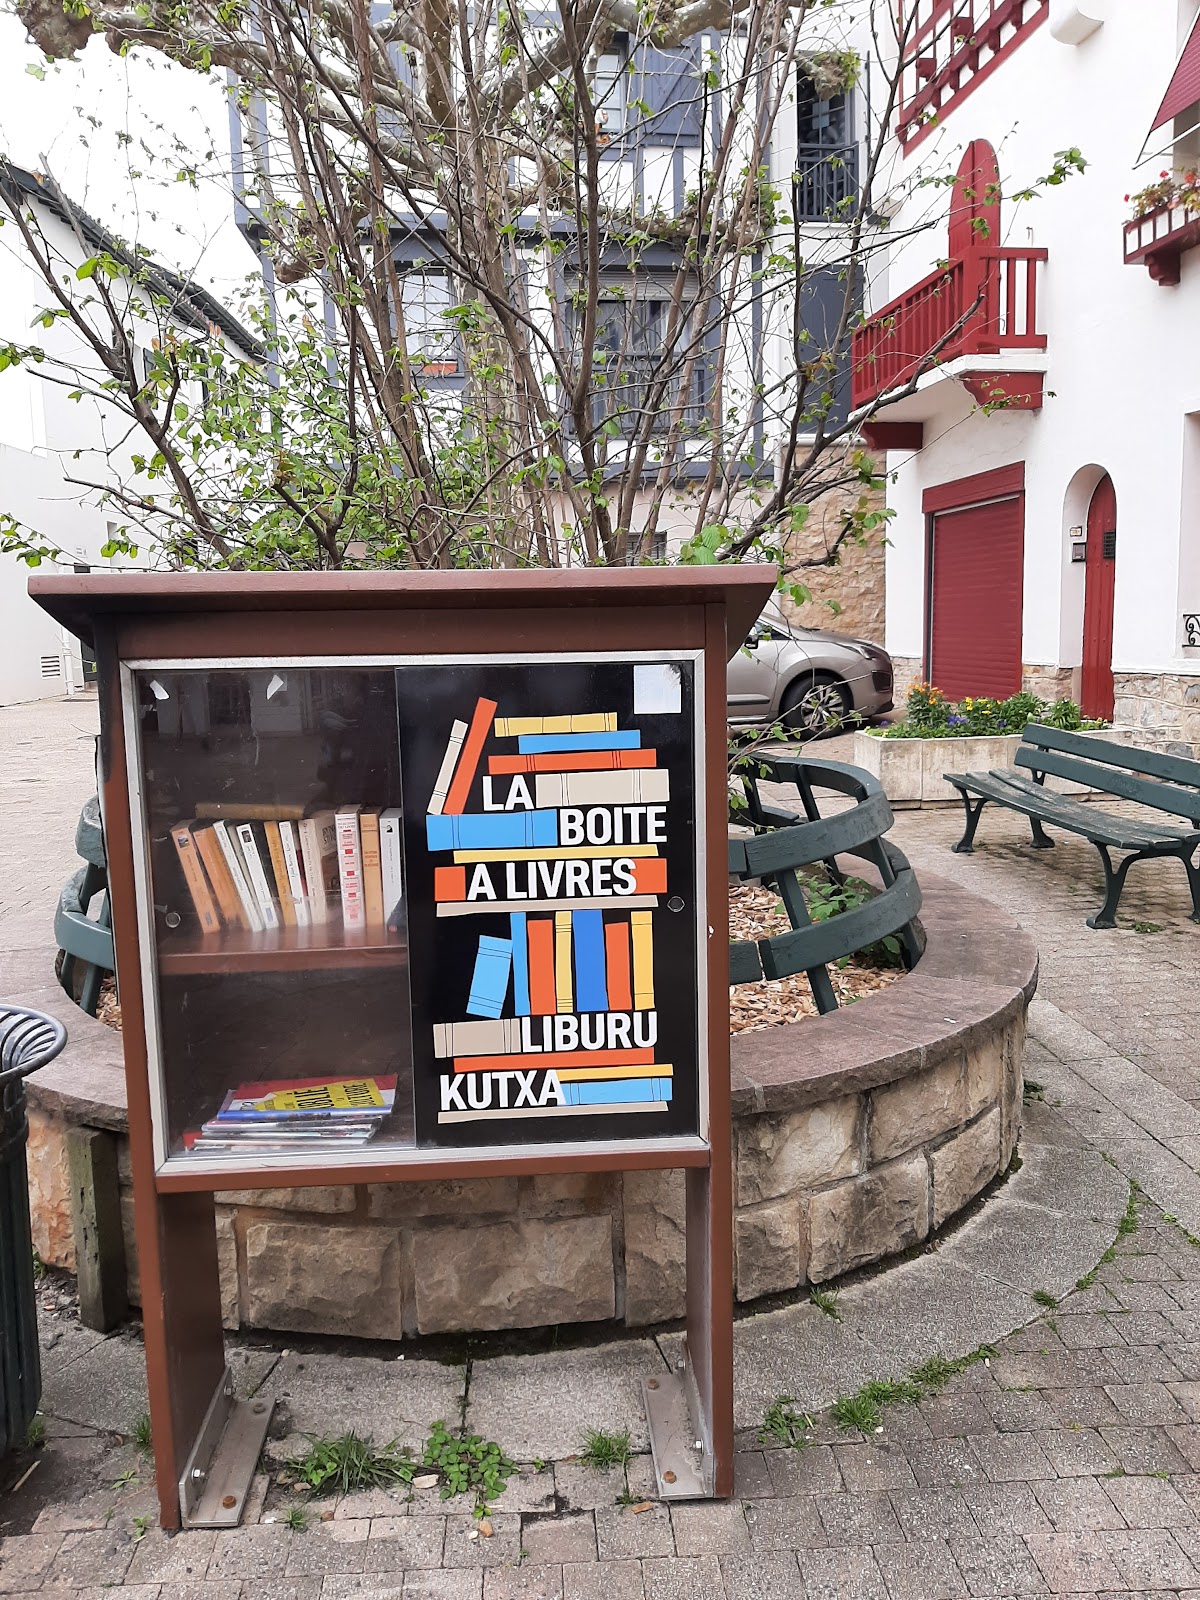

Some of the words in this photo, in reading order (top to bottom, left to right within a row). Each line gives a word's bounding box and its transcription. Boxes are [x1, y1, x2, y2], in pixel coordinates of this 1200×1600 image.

[482, 775, 535, 811] LA
[559, 806, 667, 847] BOITE
[467, 862, 497, 902] A
[506, 857, 637, 899] LIVRES
[521, 1011, 658, 1053] LIBURU
[440, 1070, 566, 1111] KUTXA
